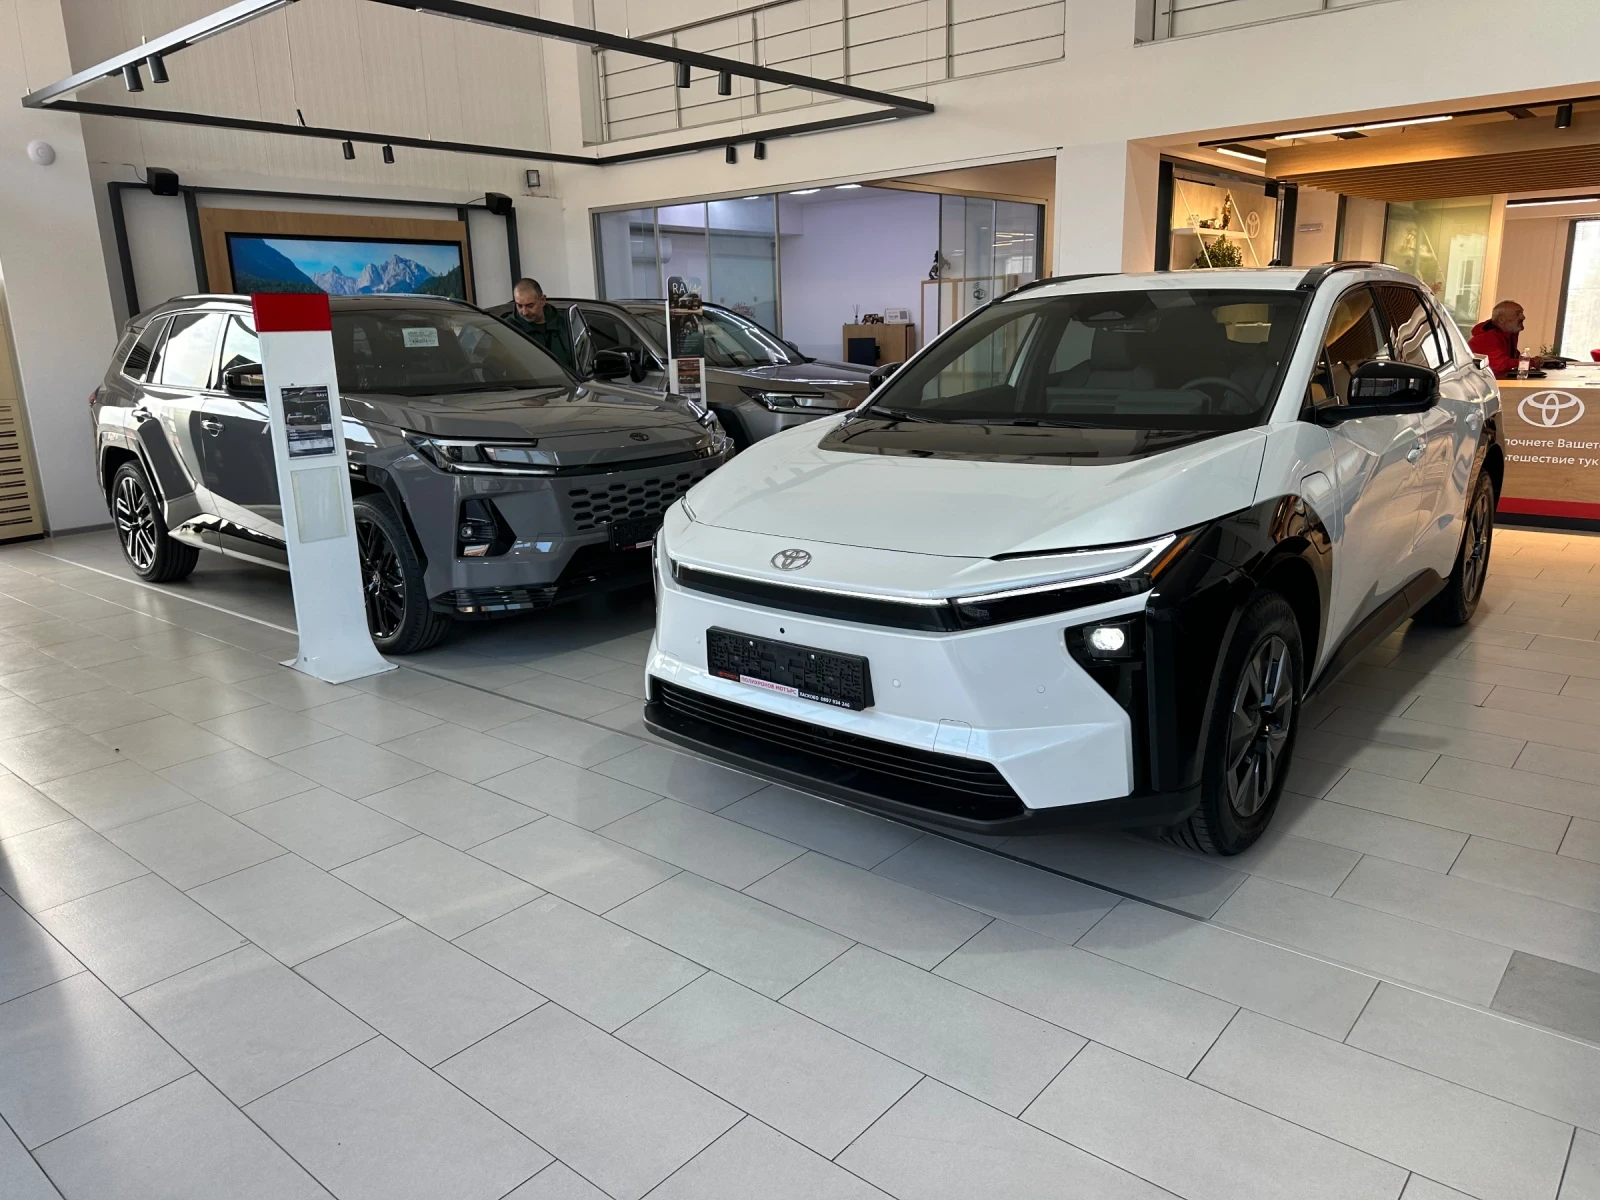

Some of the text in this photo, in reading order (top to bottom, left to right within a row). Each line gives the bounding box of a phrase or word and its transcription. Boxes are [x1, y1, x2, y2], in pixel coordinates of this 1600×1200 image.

[1504, 438, 1600, 449] почнете Вашет
[1504, 454, 1599, 468] тешествие тук
